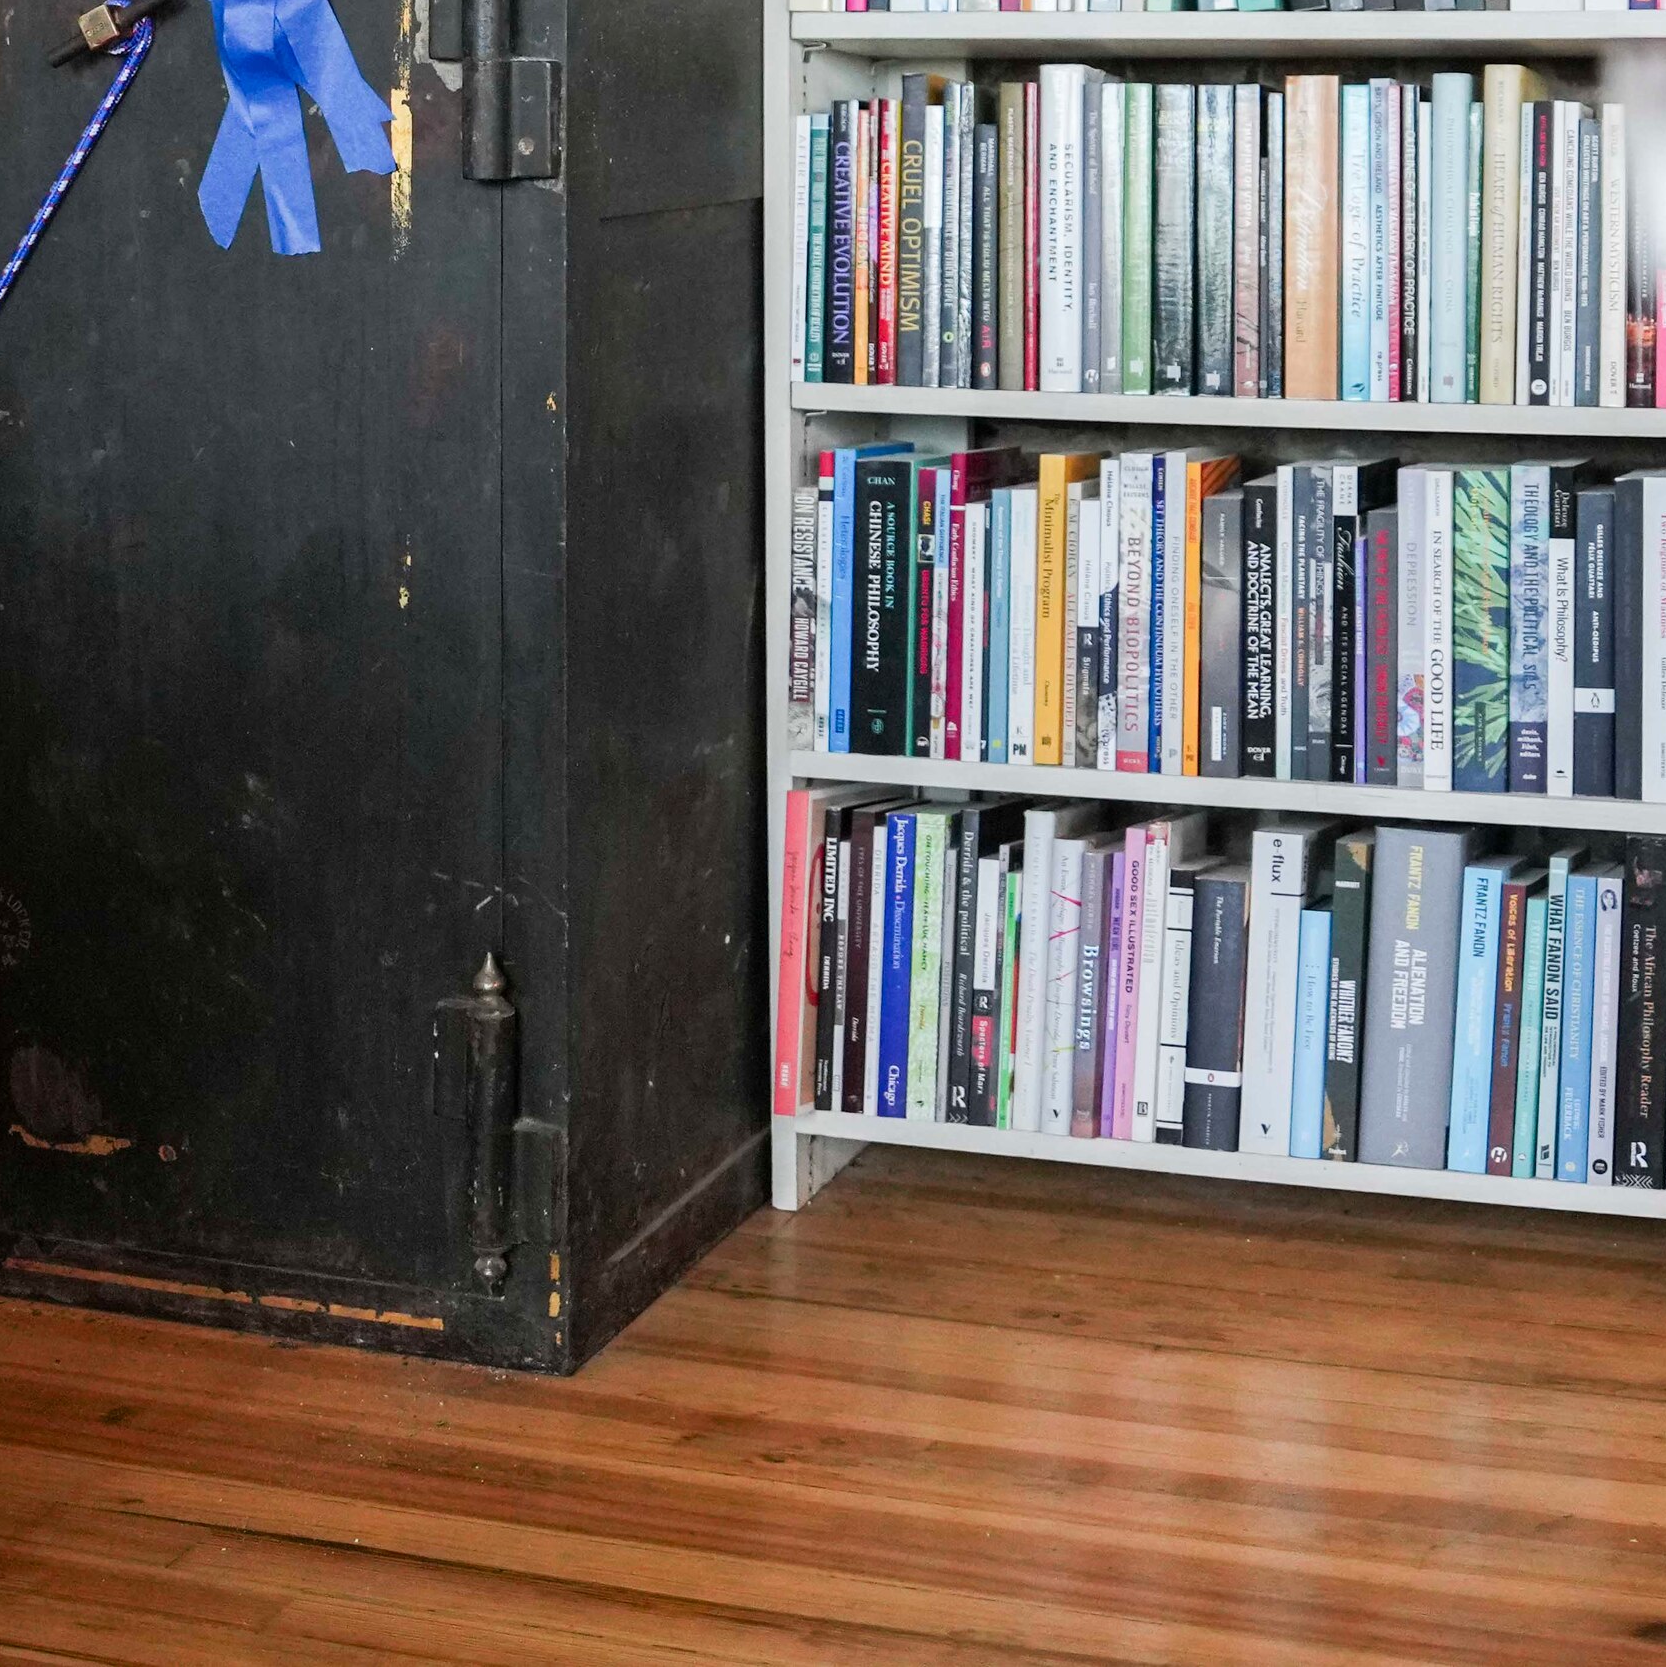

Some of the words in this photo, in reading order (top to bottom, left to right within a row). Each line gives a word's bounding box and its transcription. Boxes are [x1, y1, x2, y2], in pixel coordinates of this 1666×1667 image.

[834, 142, 851, 234] CREATIVE
[903, 139, 922, 208] CRUEL
[834, 235, 851, 344] EVOLUTION
[899, 217, 922, 332] OPTIMISM
[868, 500, 883, 570] CHINESE
[1556, 557, 1569, 586] What
[1557, 588, 1568, 598] Is
[866, 574, 881, 672] PHILOSOPHY
[1554, 599, 1569, 663] Philosophy?
[1271, 839, 1285, 882] e-flux
[1408, 845, 1423, 888] FRANTZ
[1406, 894, 1420, 930] FANON
[1076, 944, 1100, 1050] Browsings
